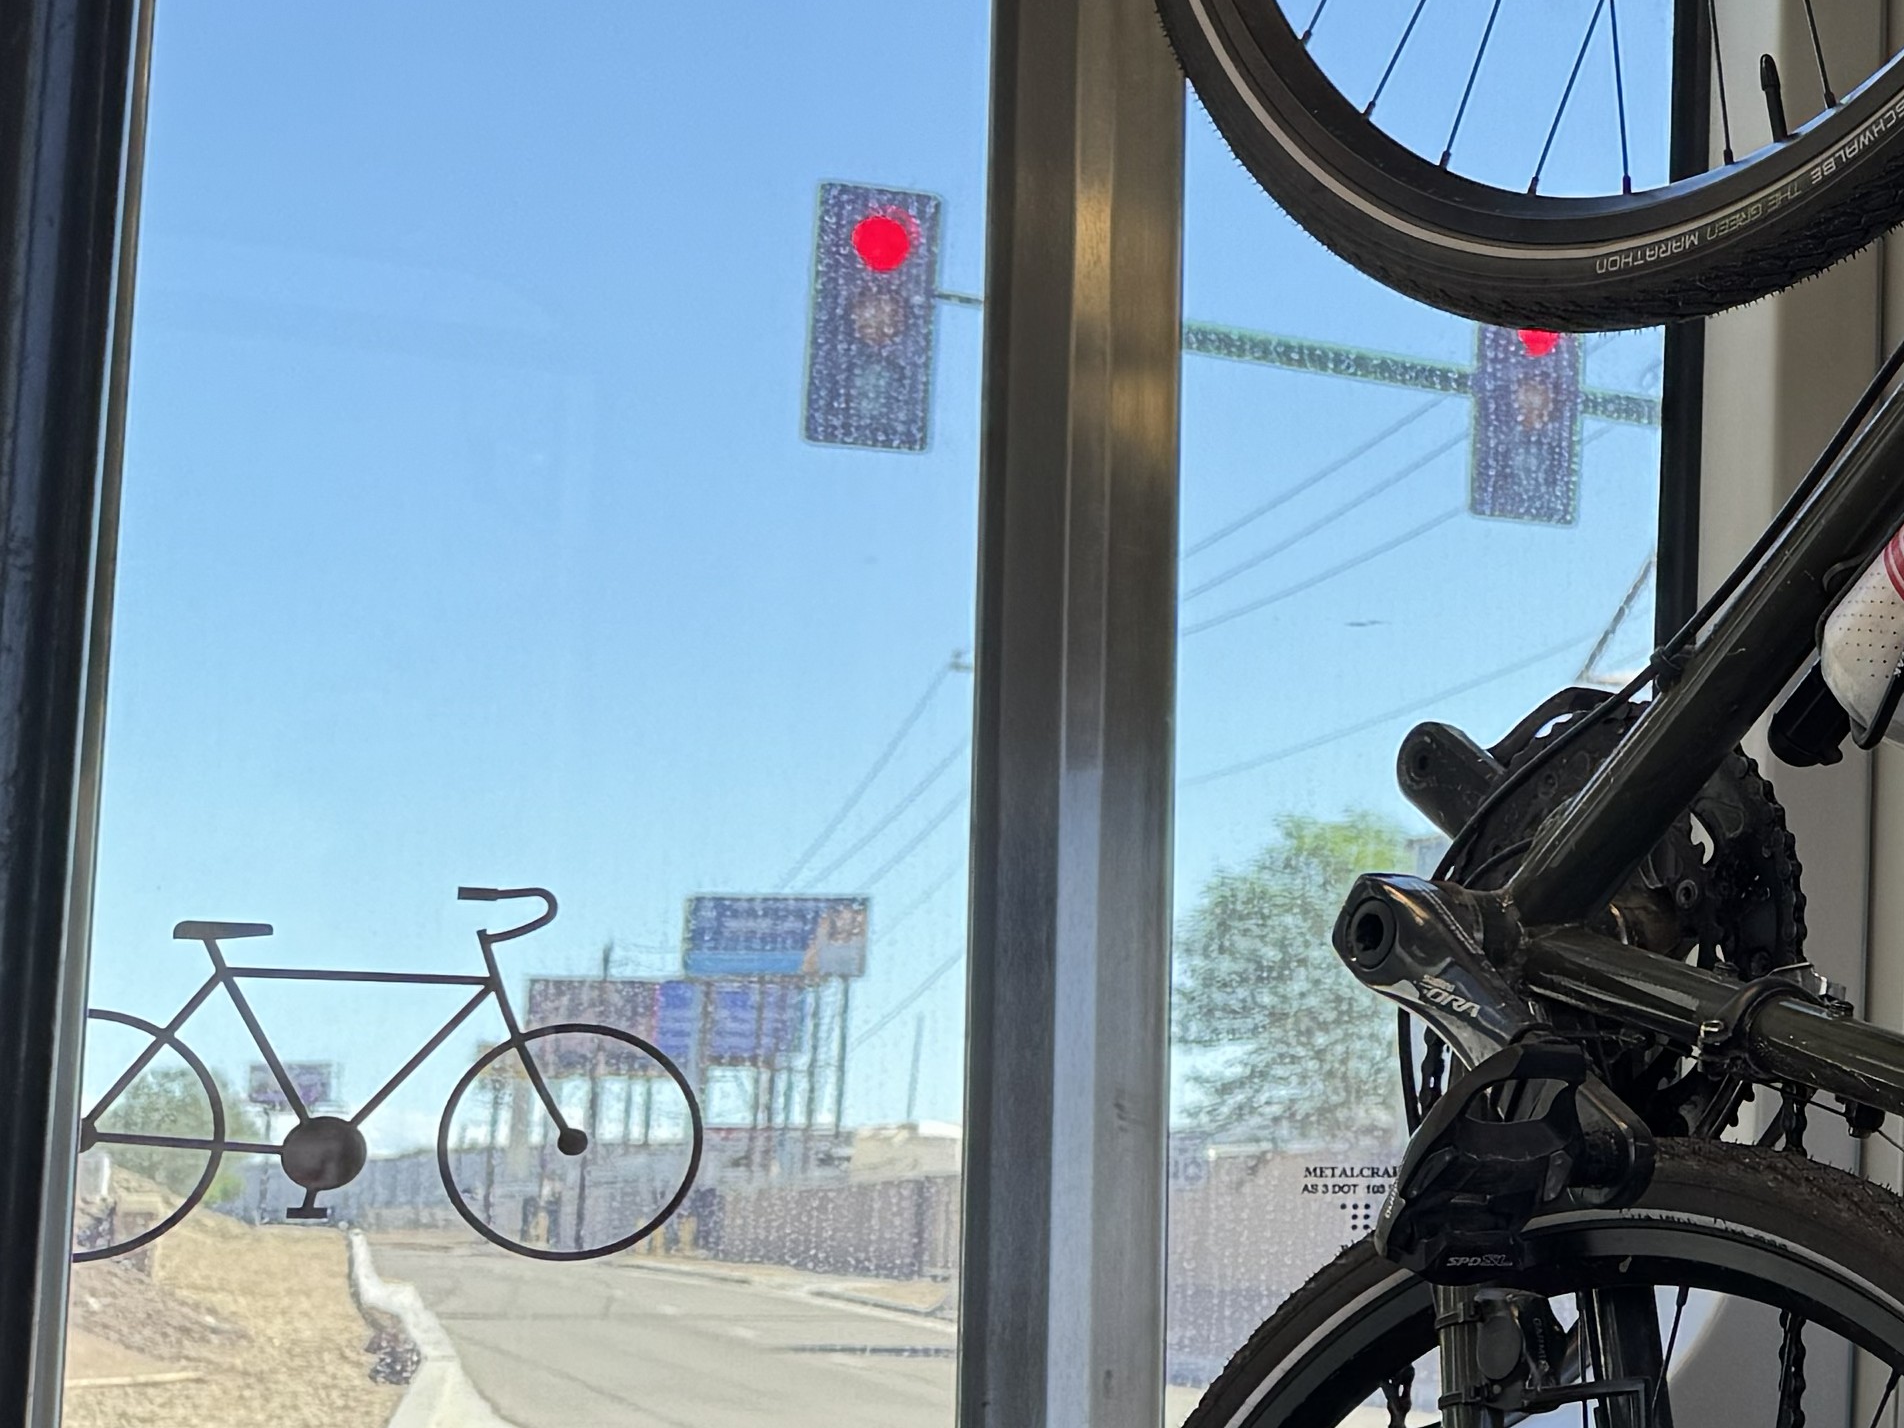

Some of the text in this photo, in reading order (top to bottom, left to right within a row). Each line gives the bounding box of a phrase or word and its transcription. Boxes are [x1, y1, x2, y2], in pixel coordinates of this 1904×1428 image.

[1768, 181, 1803, 209] THE
[1706, 202, 1766, 240] GREEN
[1595, 231, 1699, 275] MARATHON
[1300, 1183, 1319, 1195] AS
[1321, 1183, 1330, 1195] 3
[1331, 1183, 1360, 1195] DOT
